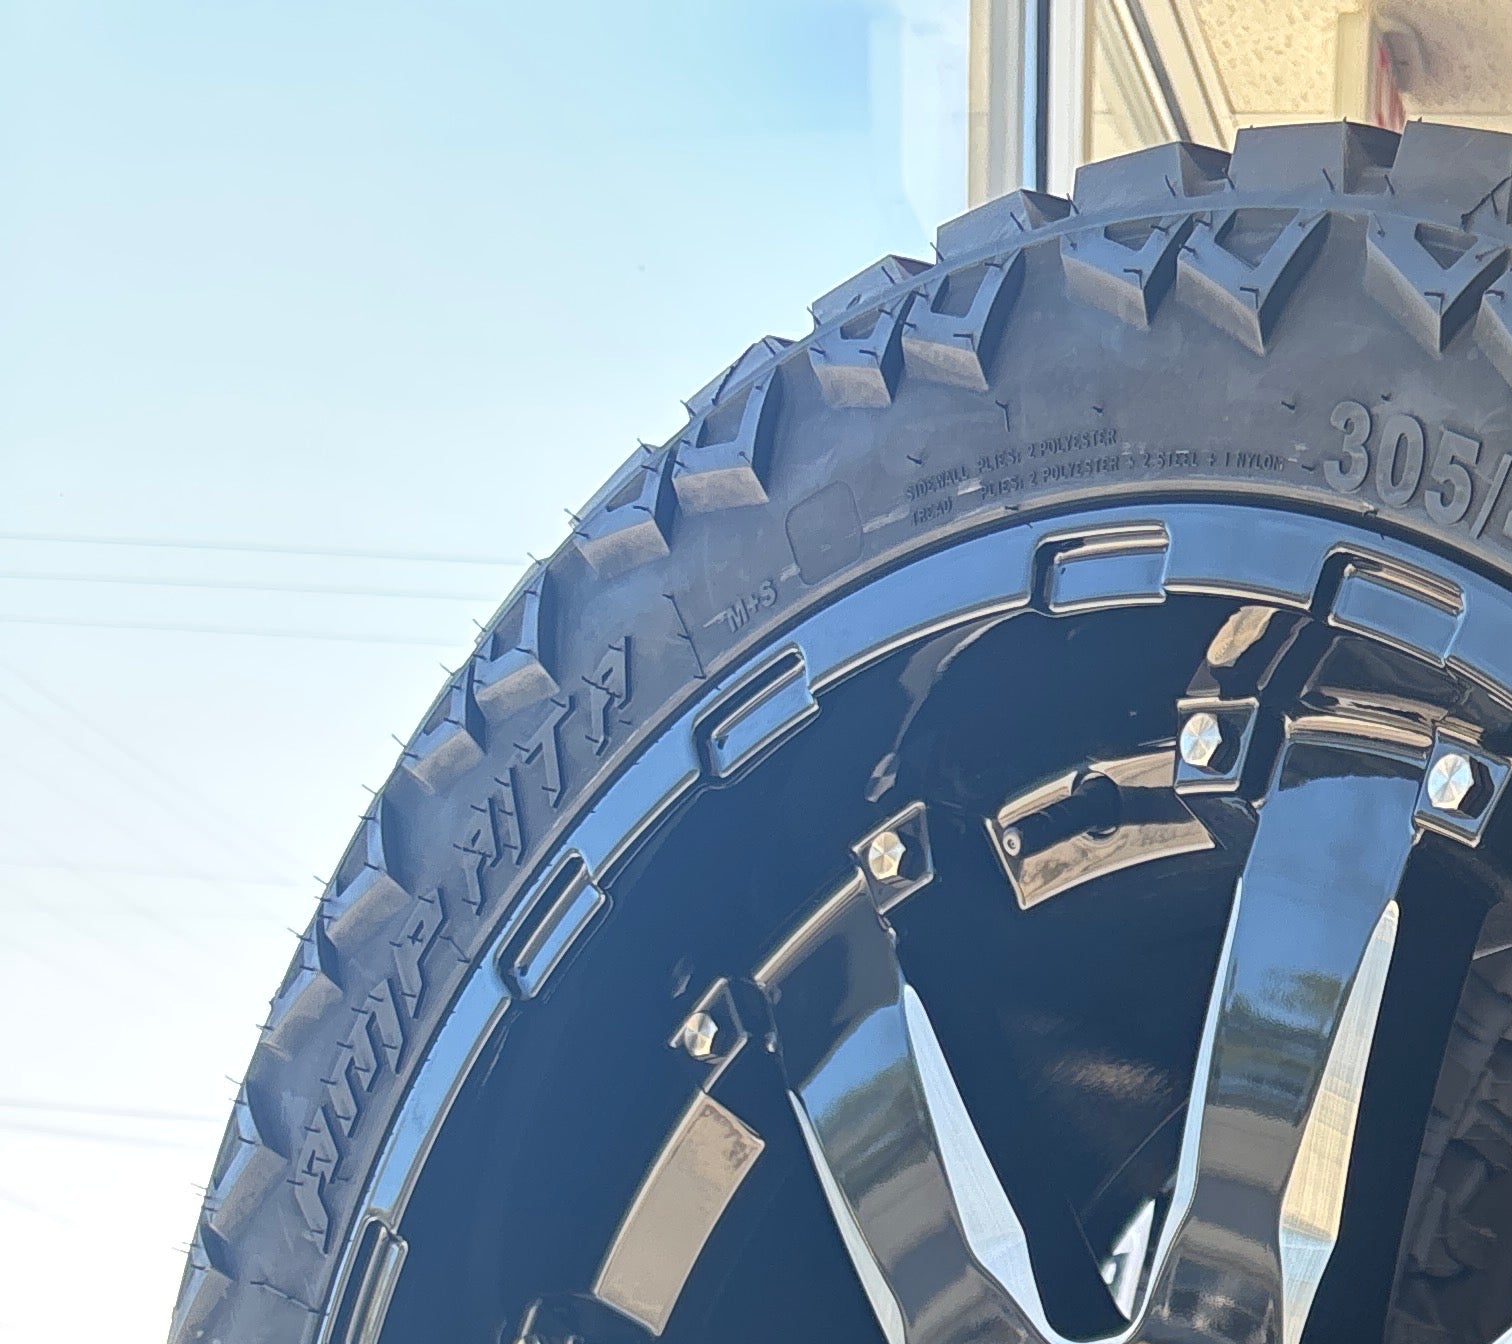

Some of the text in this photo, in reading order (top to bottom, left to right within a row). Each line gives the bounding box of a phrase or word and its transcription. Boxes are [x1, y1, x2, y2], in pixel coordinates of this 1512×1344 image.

[1040, 428, 1119, 458] POLYESTER
[1042, 455, 1120, 482] POLYESTER
[1155, 450, 1200, 469] STEEL
[1235, 451, 1285, 472] NYLON
[724, 579, 778, 634] M+S
